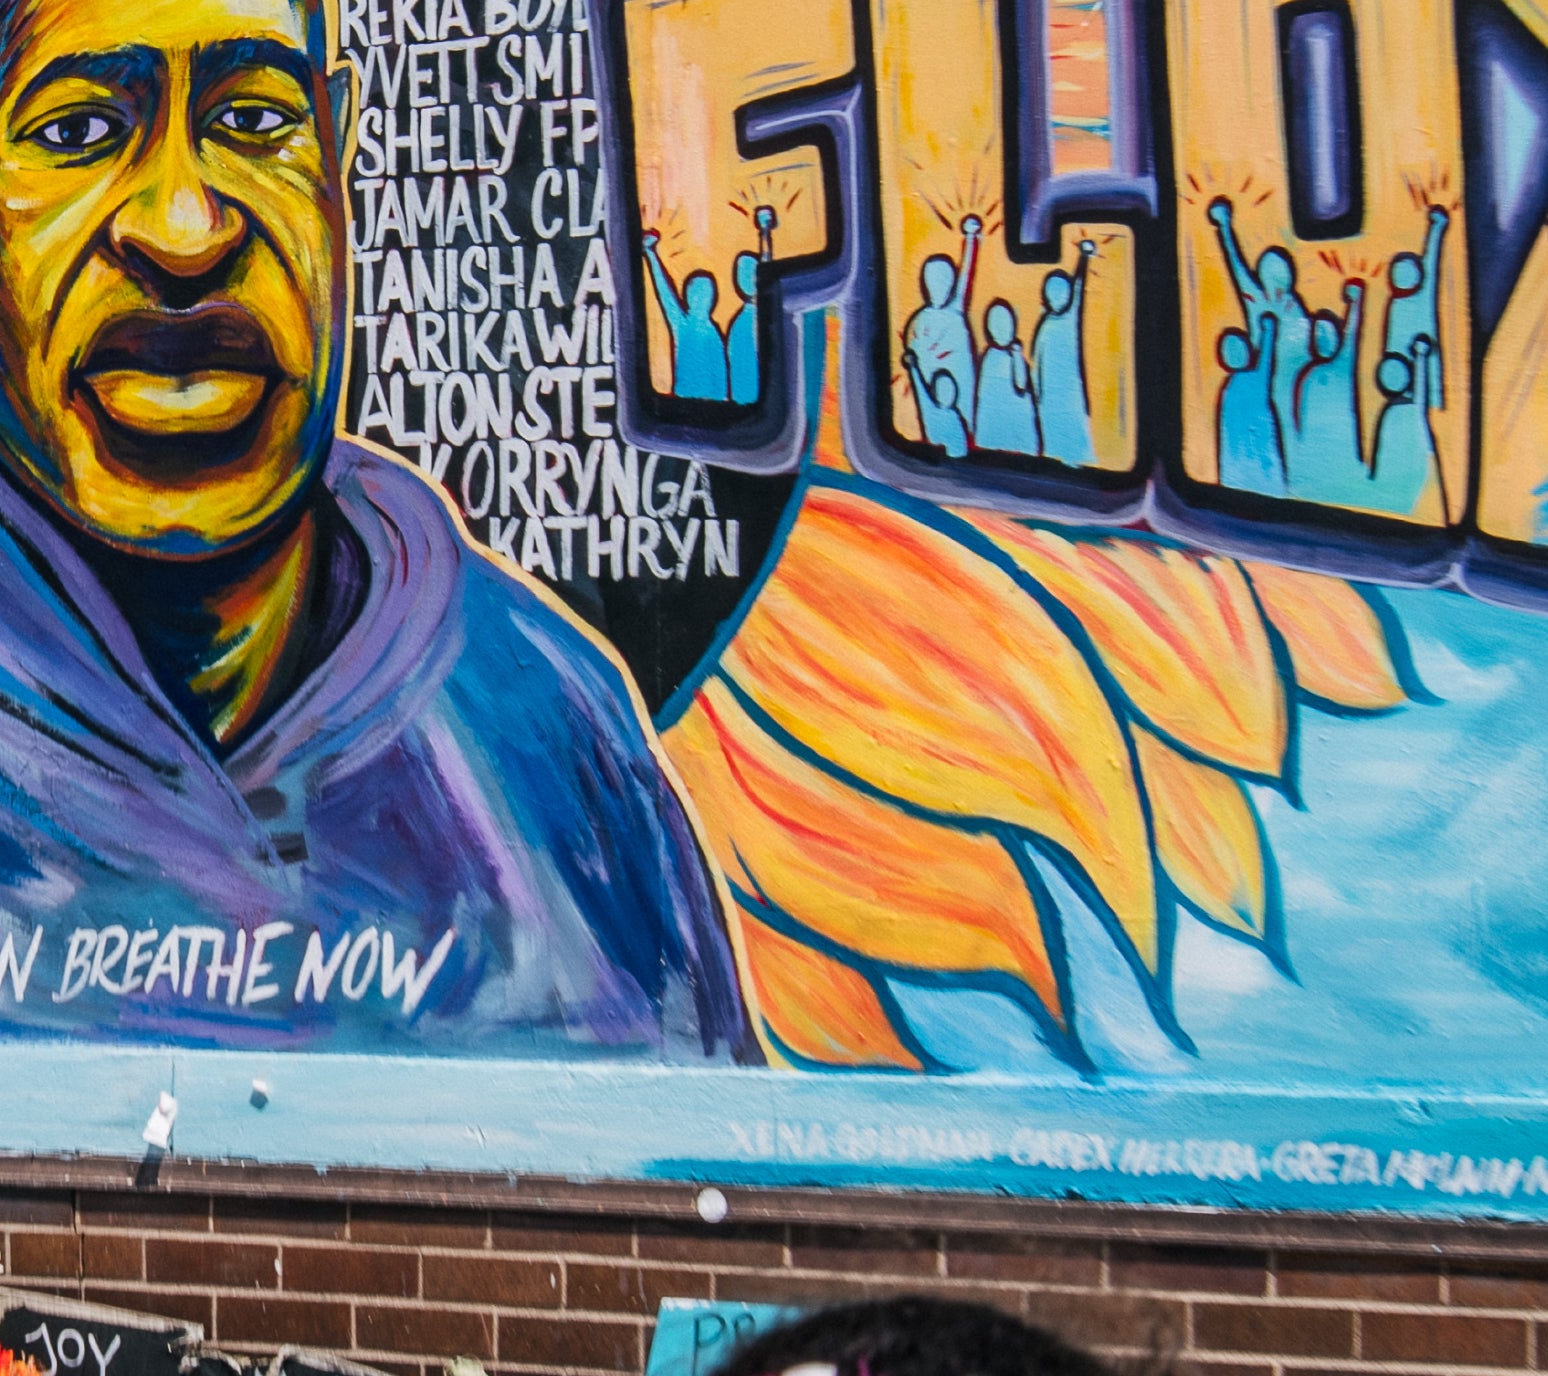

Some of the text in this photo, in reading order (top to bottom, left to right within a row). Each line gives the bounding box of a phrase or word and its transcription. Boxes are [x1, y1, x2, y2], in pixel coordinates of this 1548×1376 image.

[344, 35, 492, 110] YVETT
[491, 32, 585, 106] SMI
[354, 102, 524, 177] SHELLY
[349, 174, 522, 253] JAMAR
[353, 236, 566, 316] TANISHA
[354, 308, 536, 375] TARIKA
[357, 364, 618, 447] ALTON STE
[488, 514, 741, 585] KATHRYN
[50, 919, 295, 1007] BREATHE
[292, 924, 457, 1017] NOW
[1271, 1141, 1380, 1186] GRETA
